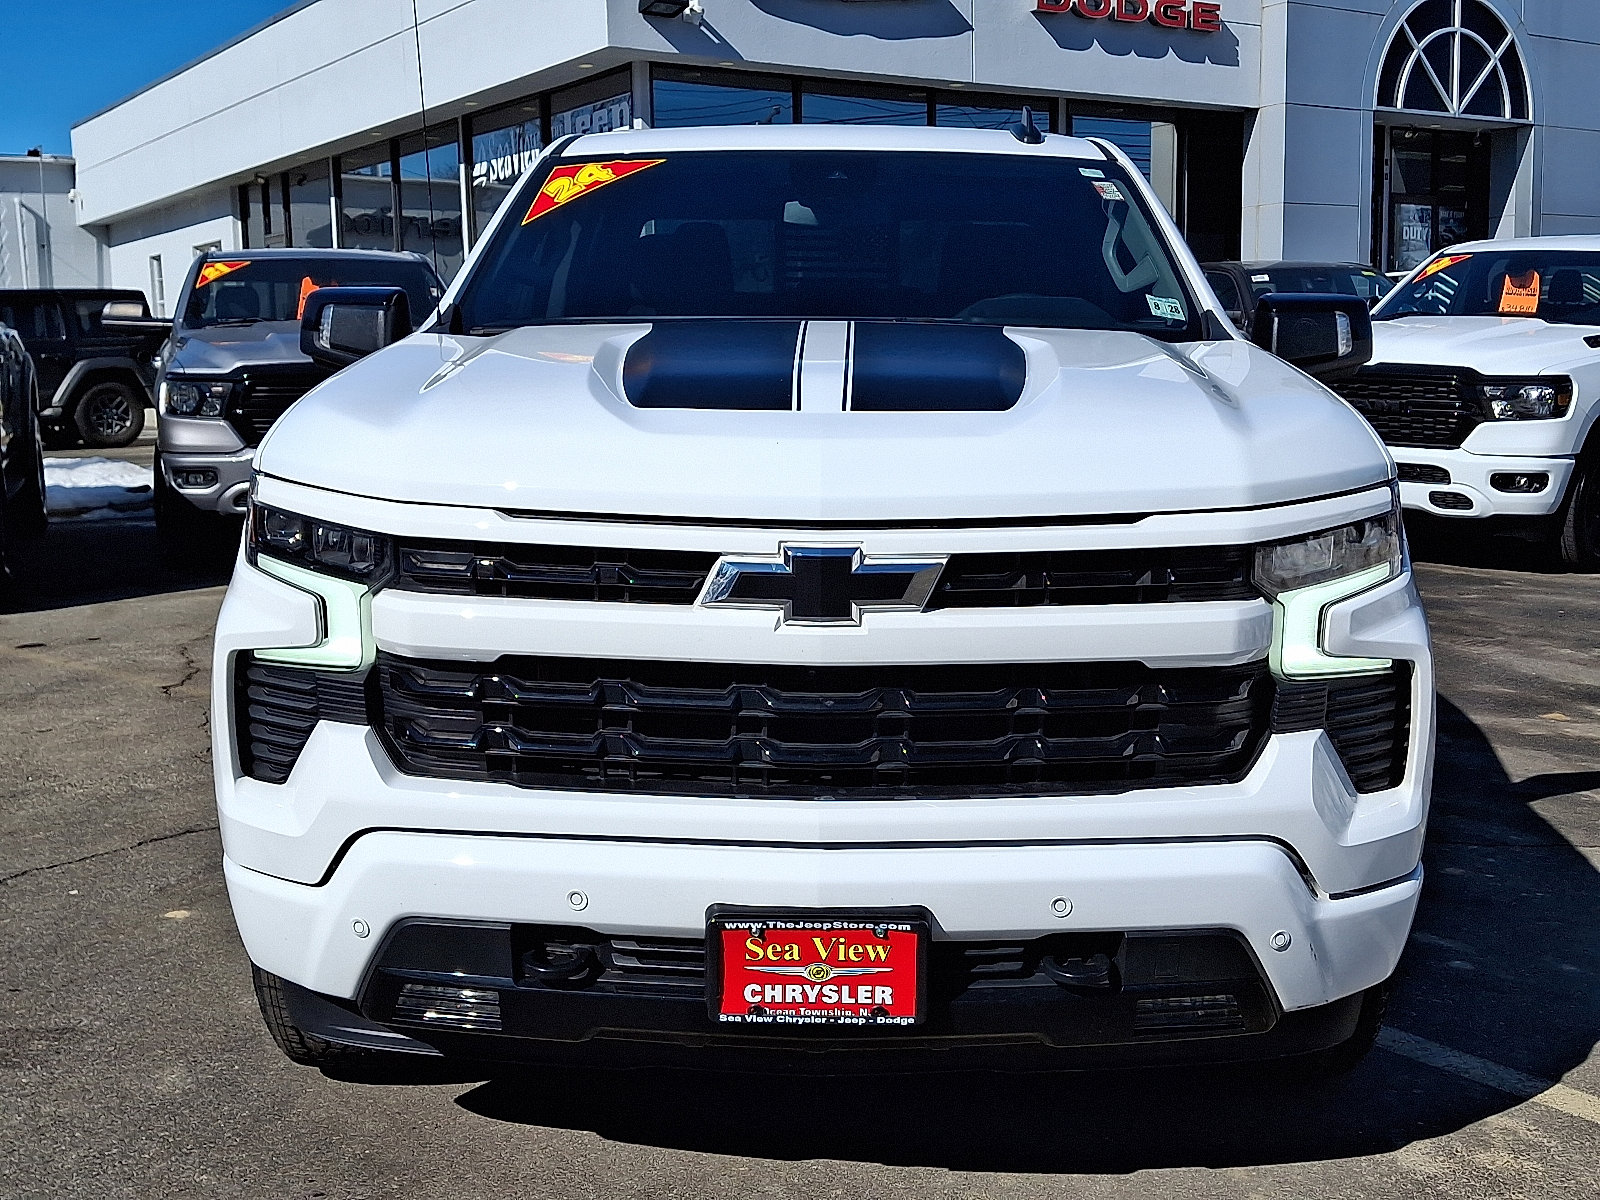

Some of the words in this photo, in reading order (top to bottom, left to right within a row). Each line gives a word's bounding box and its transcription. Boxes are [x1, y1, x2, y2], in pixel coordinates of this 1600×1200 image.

[543, 164, 617, 203] 24
[1402, 226, 1428, 241] DUTY
[1153, 301, 1161, 311] 8
[1167, 304, 1181, 315] 28
[724, 921, 912, 931] www.TheJeepStore.com
[745, 937, 801, 961] Sea
[811, 937, 891, 962] View
[743, 983, 893, 1005] CHRYSLER
[719, 1014, 742, 1022] Sea
[744, 1014, 773, 1023] View
[776, 1015, 827, 1024] Chrysler
[838, 1016, 866, 1025] Jeep
[877, 1016, 915, 1026] Dodge
